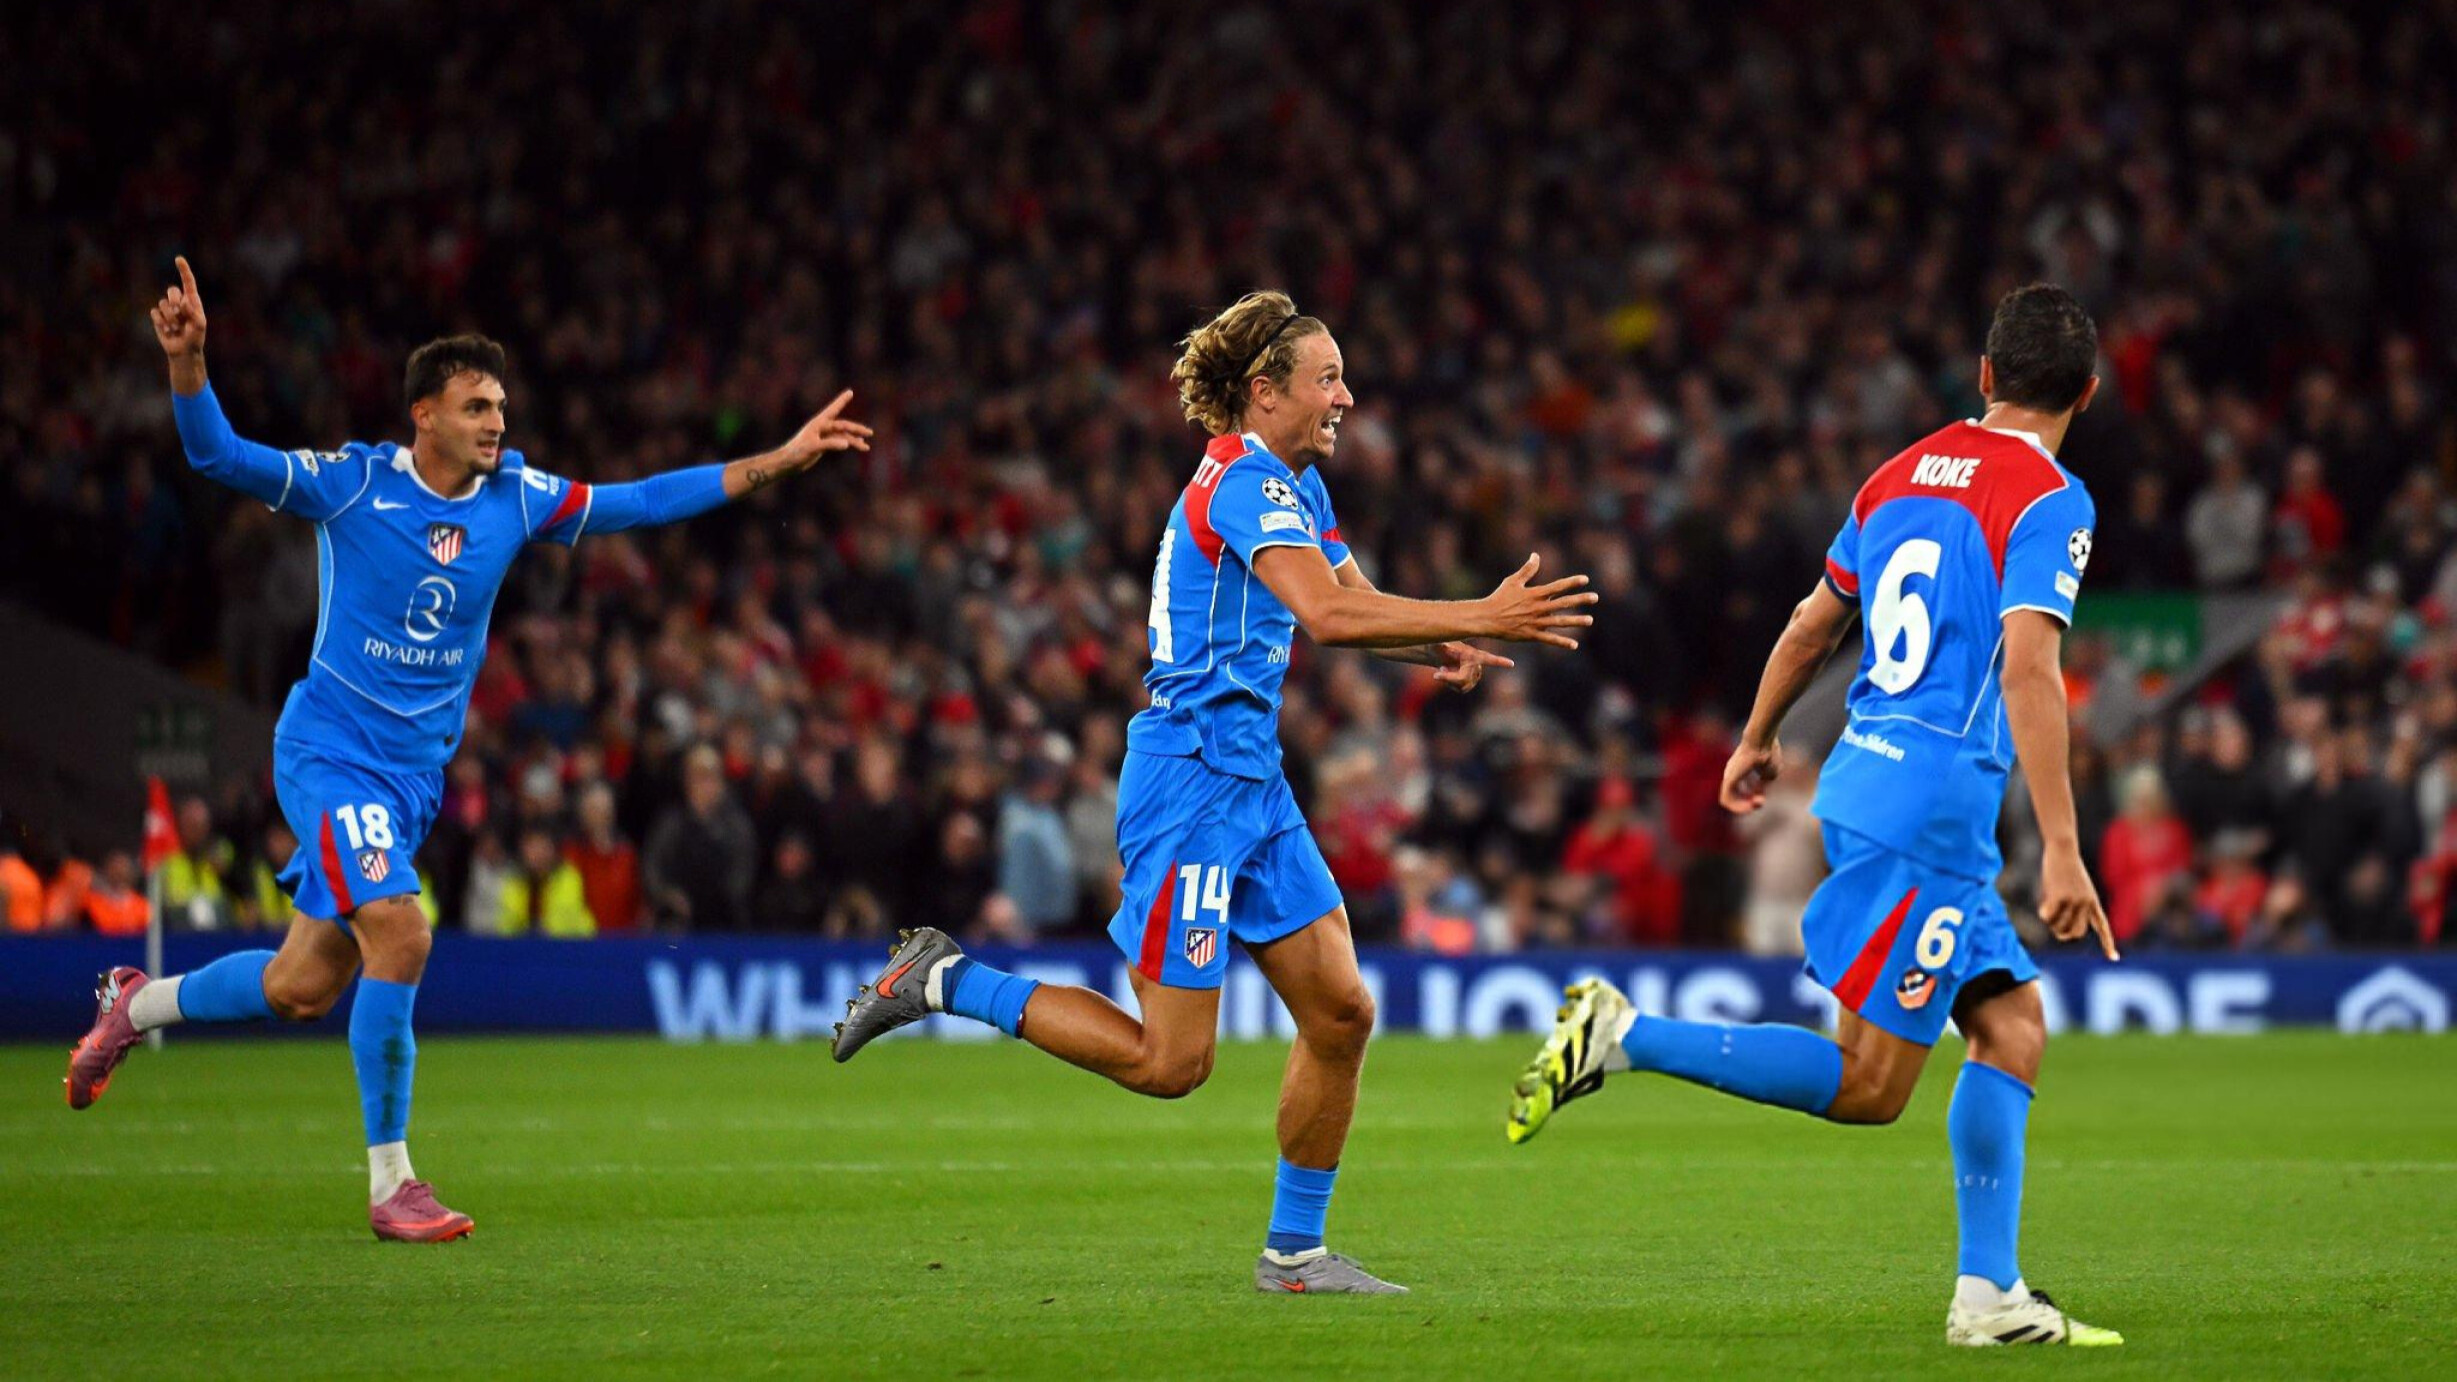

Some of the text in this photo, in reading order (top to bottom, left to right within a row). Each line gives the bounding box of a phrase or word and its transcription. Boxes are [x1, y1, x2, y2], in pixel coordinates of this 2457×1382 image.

[1911, 454, 1980, 488] KOKE
[1868, 539, 1942, 695] 6
[364, 638, 465, 665] RIYADH AIR
[336, 803, 394, 849] 18
[1179, 864, 1231, 923] 14
[1916, 907, 1963, 968] 6
